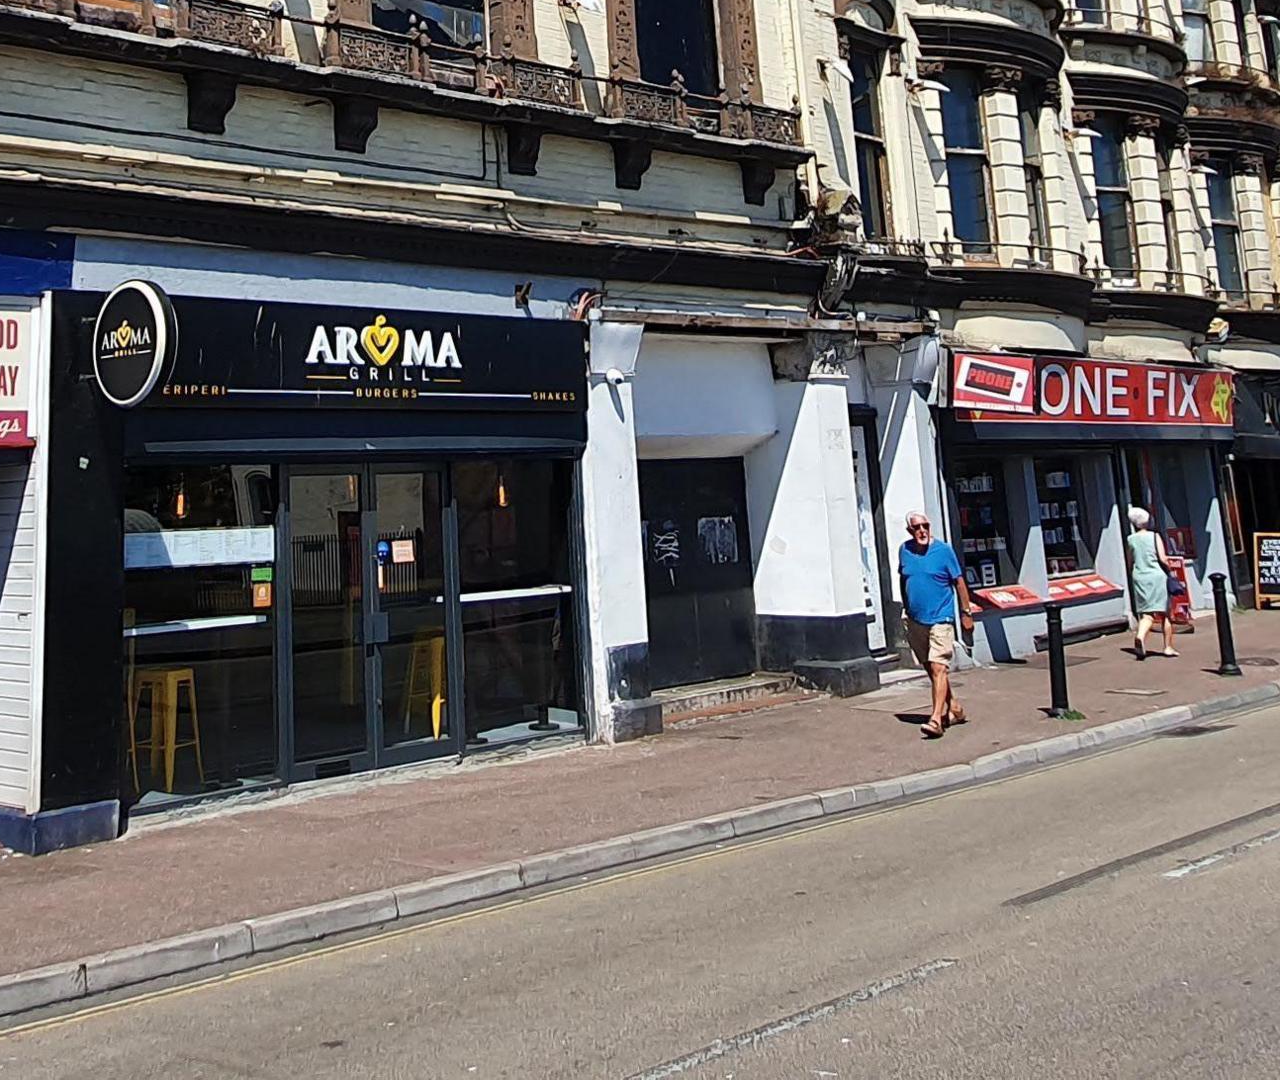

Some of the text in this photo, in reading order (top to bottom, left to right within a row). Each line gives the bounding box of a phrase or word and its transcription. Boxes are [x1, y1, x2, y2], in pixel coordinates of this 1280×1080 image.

[349, 366, 431, 382] GRILL
[967, 367, 1014, 391] PHONE
[356, 387, 418, 400] BURGERS
[532, 391, 576, 401] SHAKES
[1041, 363, 1129, 417] ONE
[1147, 369, 1201, 418] FIX
